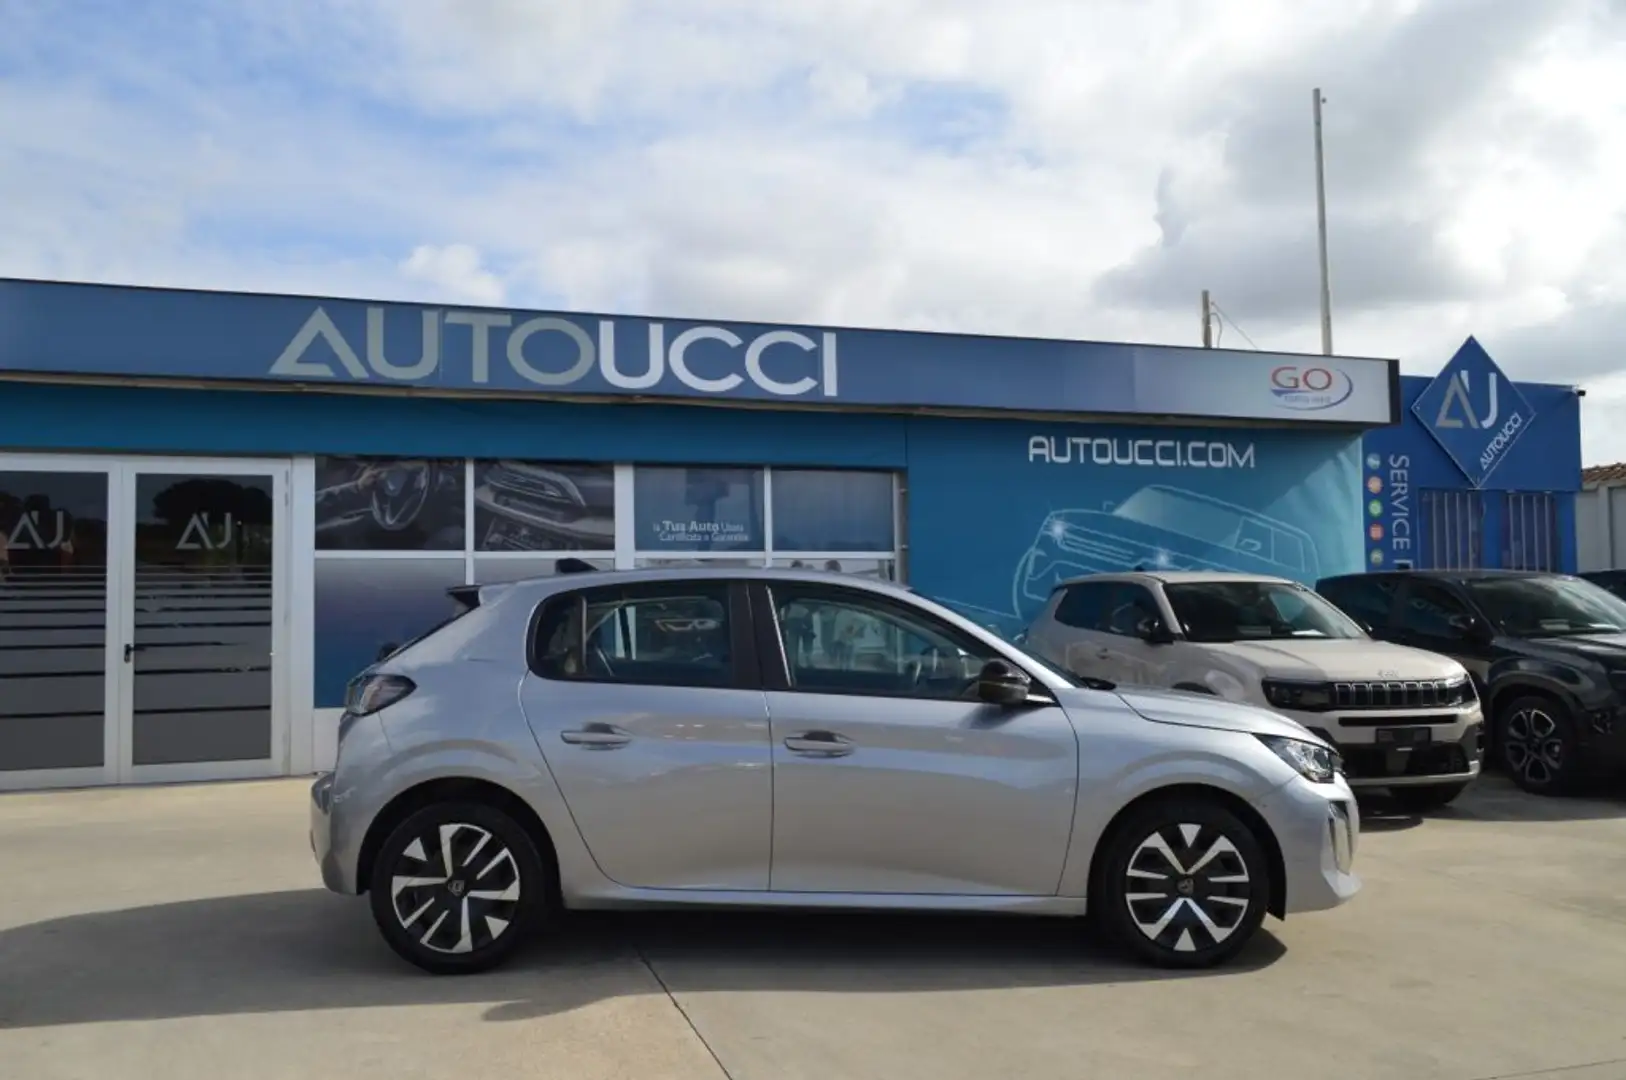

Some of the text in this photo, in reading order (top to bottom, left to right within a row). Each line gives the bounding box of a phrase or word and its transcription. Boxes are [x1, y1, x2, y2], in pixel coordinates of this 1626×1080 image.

[268, 305, 837, 397] AUTOUCCI
[1271, 366, 1332, 391] GO
[1028, 436, 1255, 469] AUTOUCCI.COM
[1480, 412, 1523, 470] AUTOUCCI
[1389, 454, 1411, 549] SERVICE
